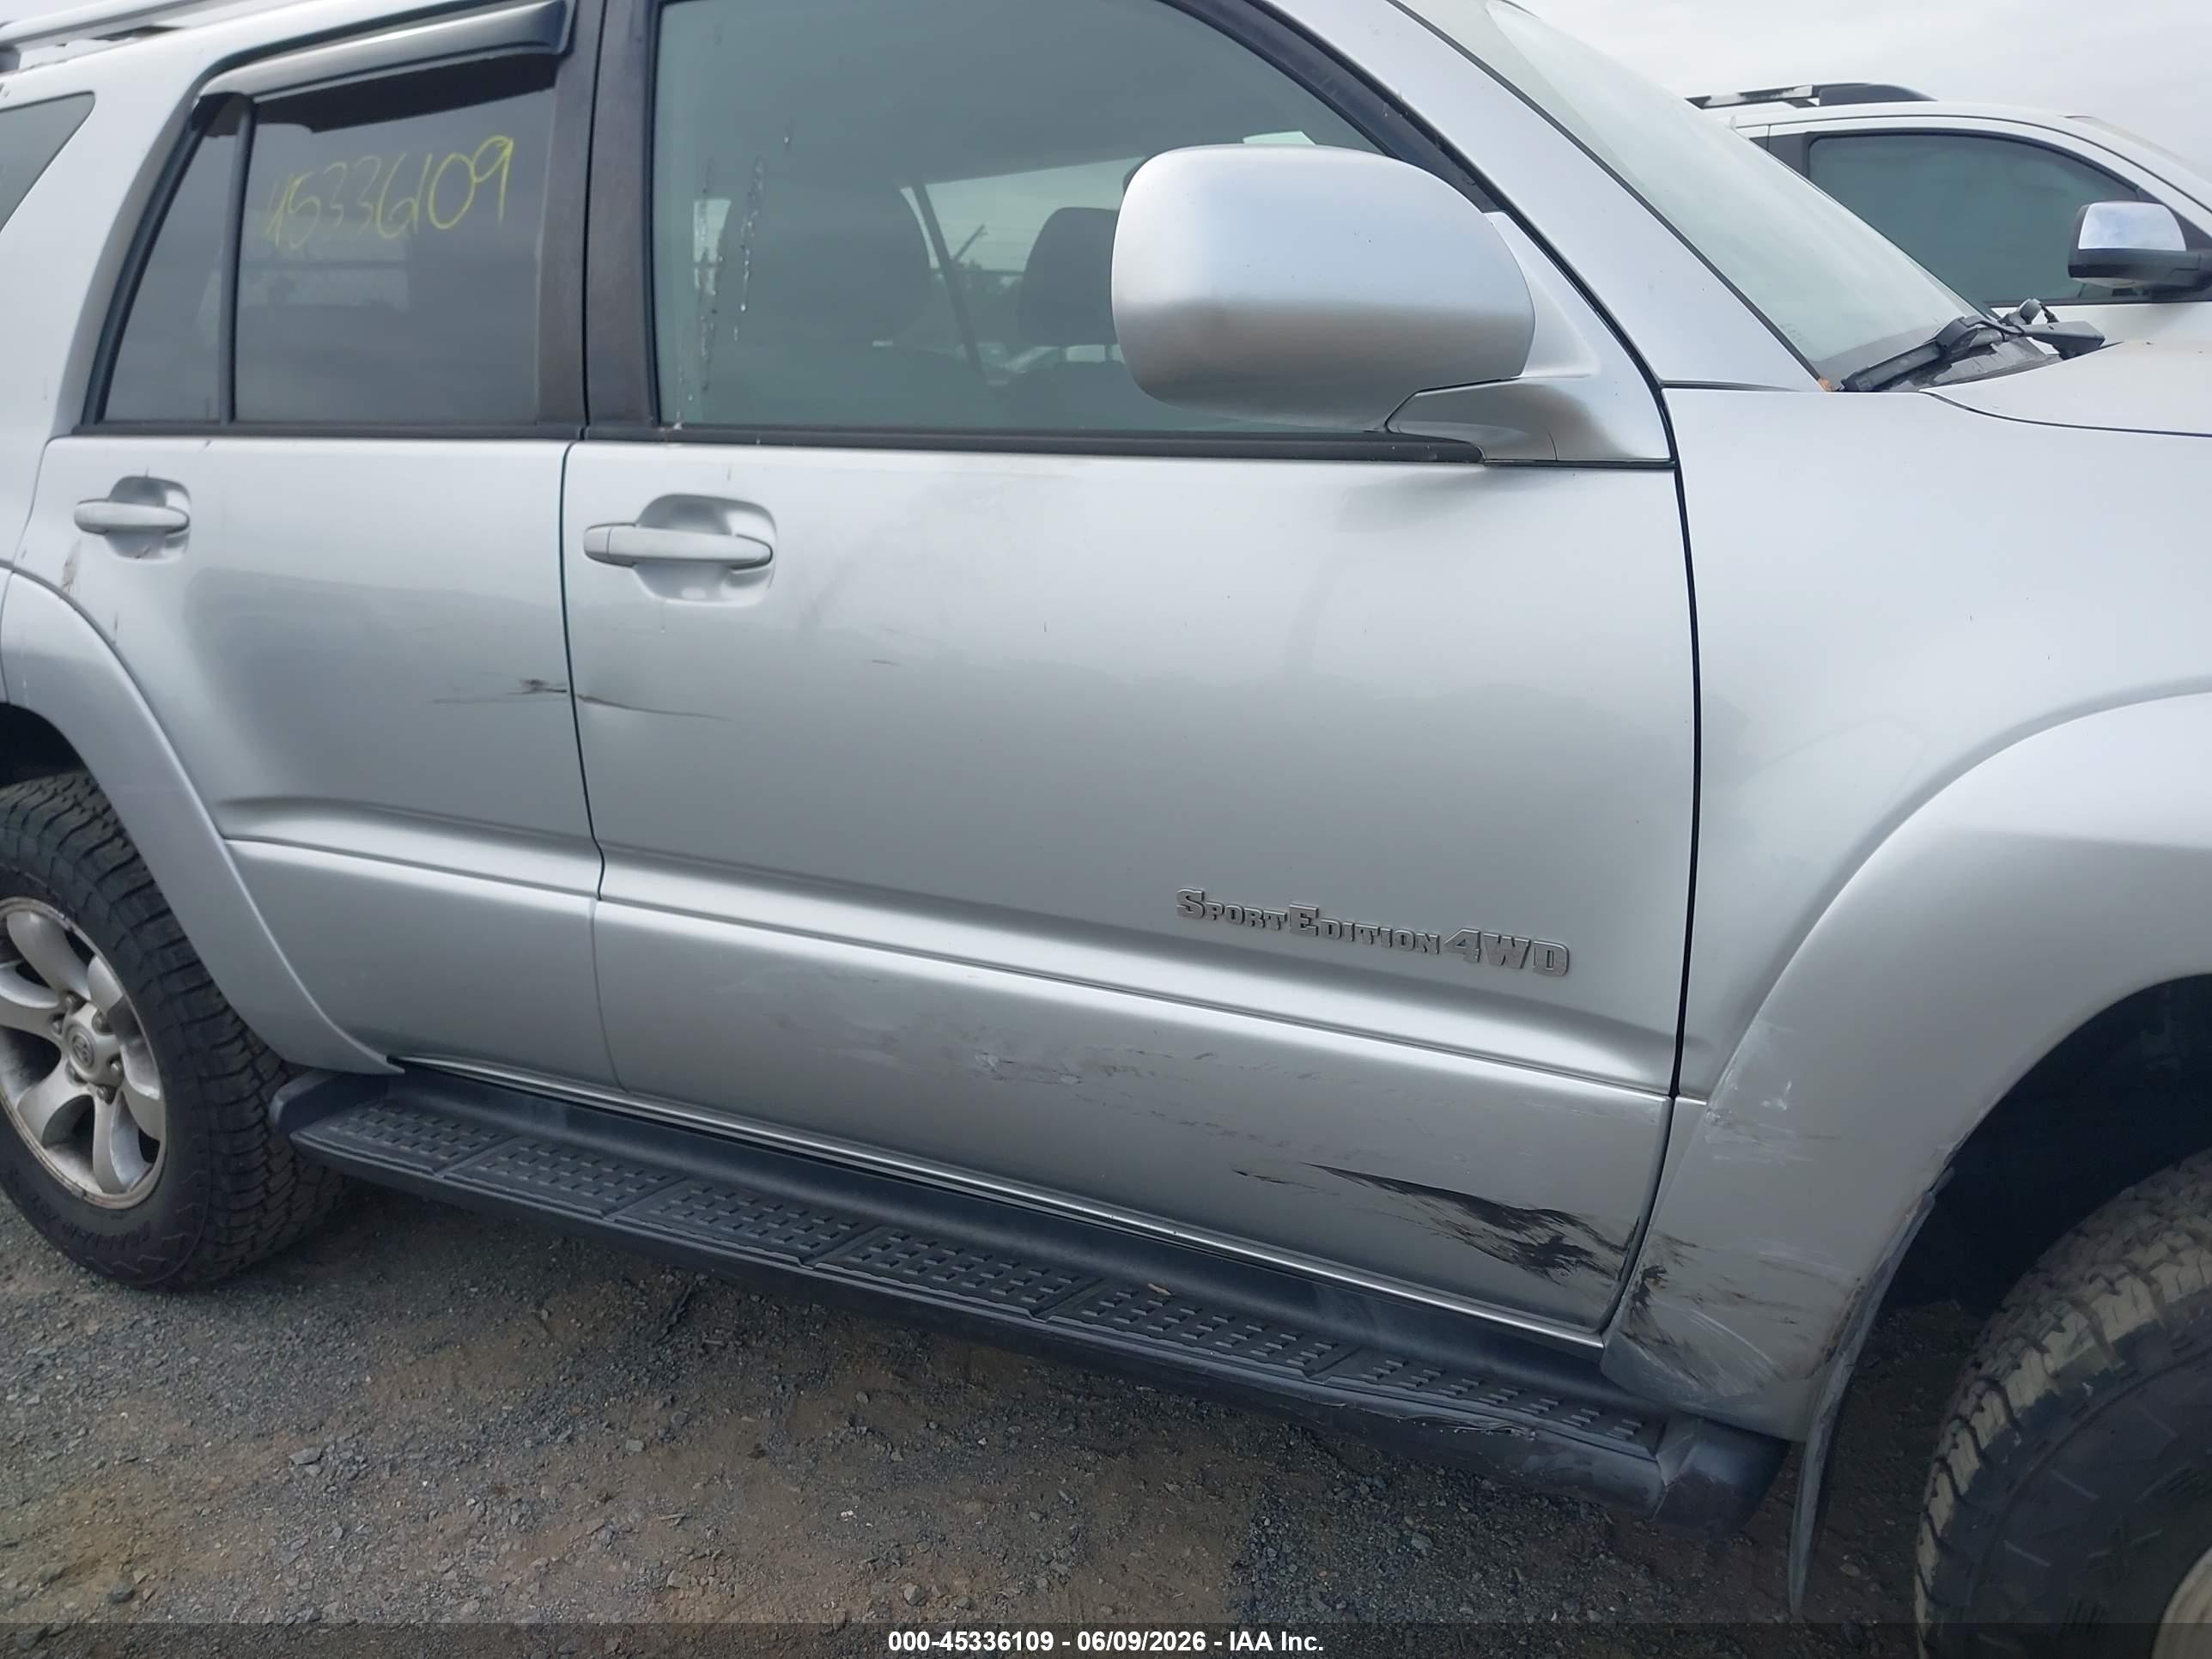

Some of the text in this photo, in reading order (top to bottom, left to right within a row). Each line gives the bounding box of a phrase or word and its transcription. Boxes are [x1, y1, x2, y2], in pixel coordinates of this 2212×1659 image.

[1176, 886, 1570, 977] SPORT EDITION 4WD
